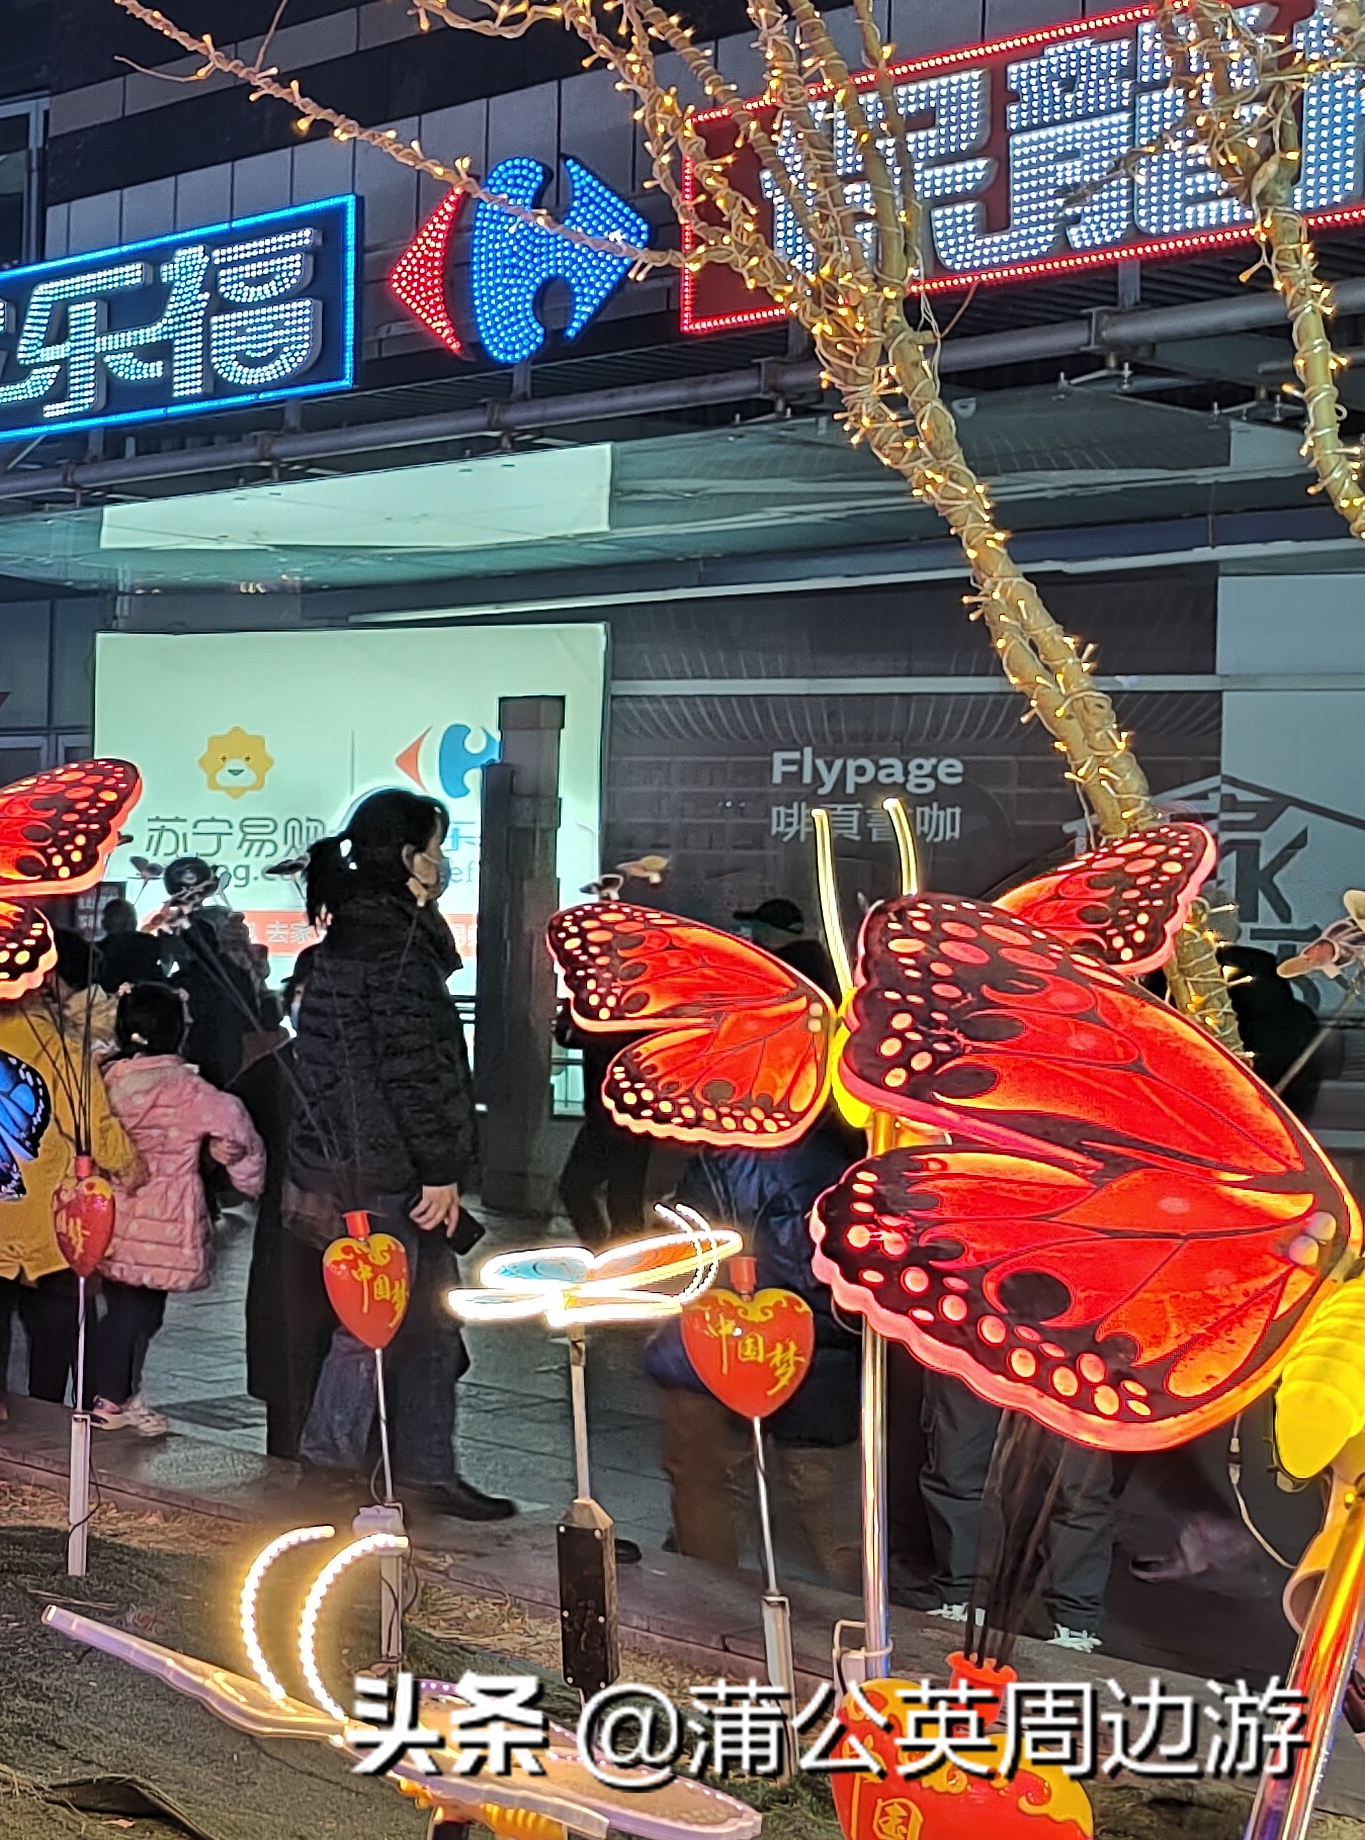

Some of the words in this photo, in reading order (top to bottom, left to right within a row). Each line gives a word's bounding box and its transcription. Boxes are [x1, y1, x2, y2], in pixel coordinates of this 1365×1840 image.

[771, 746, 965, 796] Flypage
[145, 815, 327, 858] 苏宁易购
[350, 1259, 410, 1328] 中国梦
[706, 1313, 807, 1396] 中国梦
